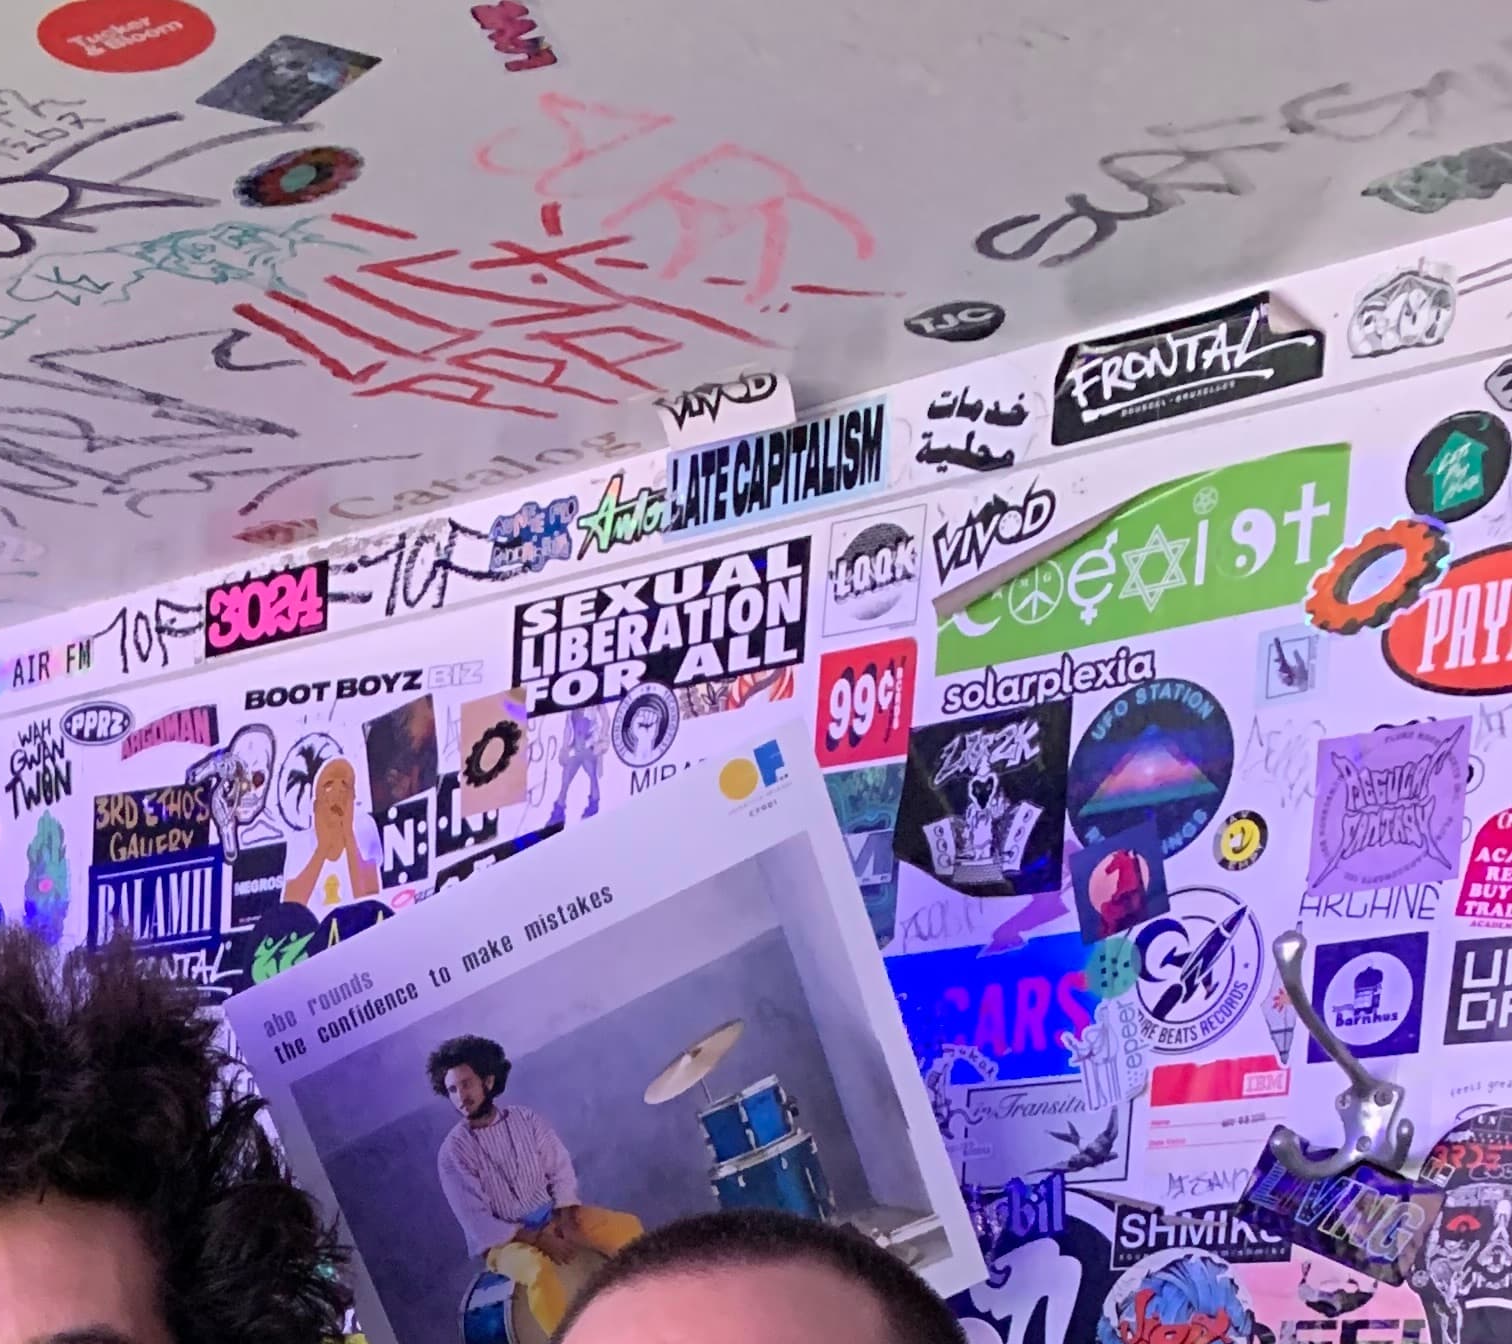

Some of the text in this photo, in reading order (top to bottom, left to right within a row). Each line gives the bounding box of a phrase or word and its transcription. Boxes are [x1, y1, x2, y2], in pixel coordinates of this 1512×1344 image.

[104, 19, 183, 51] Bloom
[1068, 305, 1316, 410] FRONTAL
[671, 403, 885, 533] LATE CAPITALISM
[208, 567, 324, 648] 3024
[522, 540, 803, 637] SEXUAL
[521, 576, 803, 682] LIBERATION
[1416, 578, 1512, 676] PAY
[13, 652, 51, 687] AIR
[66, 641, 91, 674] FM
[245, 660, 484, 710] BOOT BOYZ BIZ
[525, 625, 798, 714] FOR ALL
[942, 647, 1156, 714] solarplexia
[18, 718, 53, 746] WAH
[70, 709, 125, 739] PPRZ
[1091, 683, 1216, 742] UFO STATION
[9, 736, 66, 776] GWAN
[273, 884, 615, 1066] the confidence to make mistakes
[306, 968, 375, 1016] rounds
[1158, 980, 1250, 1045] BEATS RECORDS
[1335, 1009, 1399, 1028] Barnhus
[1245, 1074, 1284, 1093] IBM
